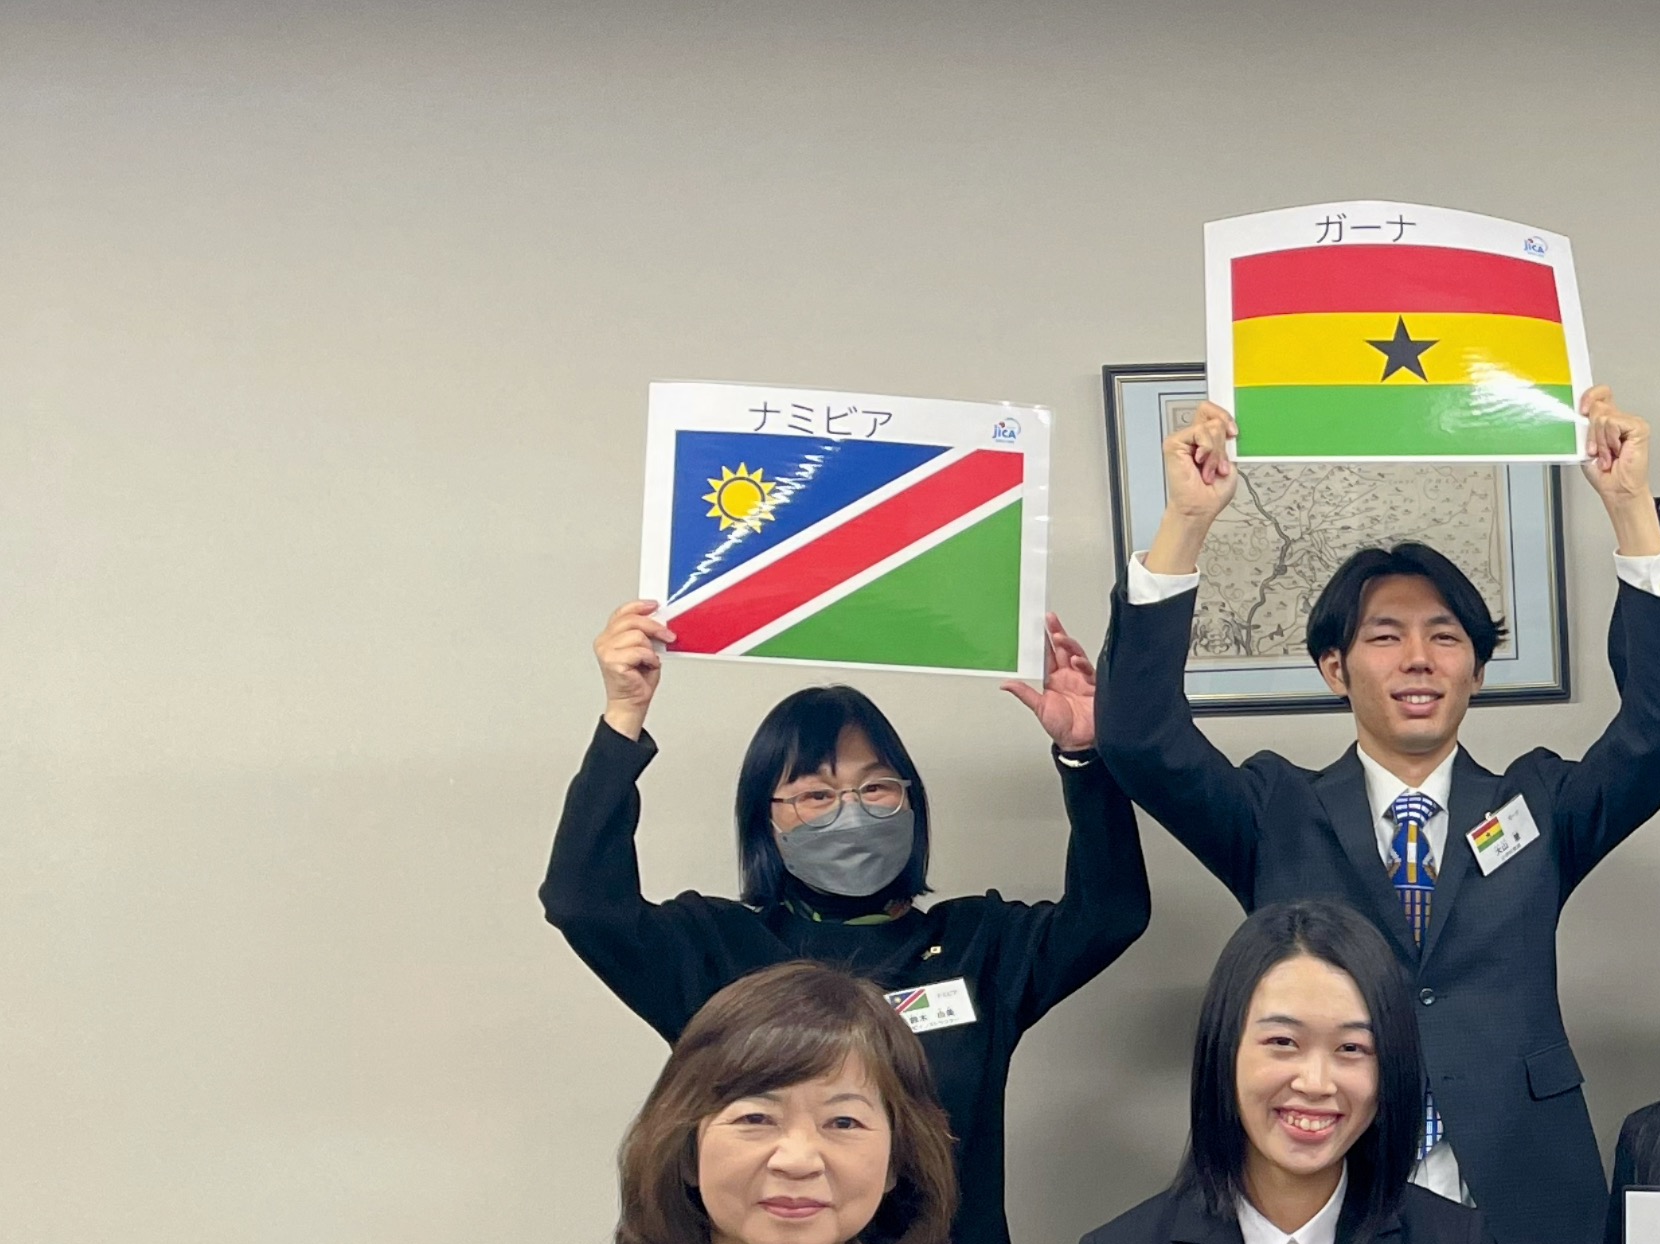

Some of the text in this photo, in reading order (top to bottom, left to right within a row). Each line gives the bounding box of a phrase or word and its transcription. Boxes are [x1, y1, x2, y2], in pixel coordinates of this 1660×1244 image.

[1315, 213, 1417, 244] ガーナ
[748, 401, 893, 438] ナミビア
